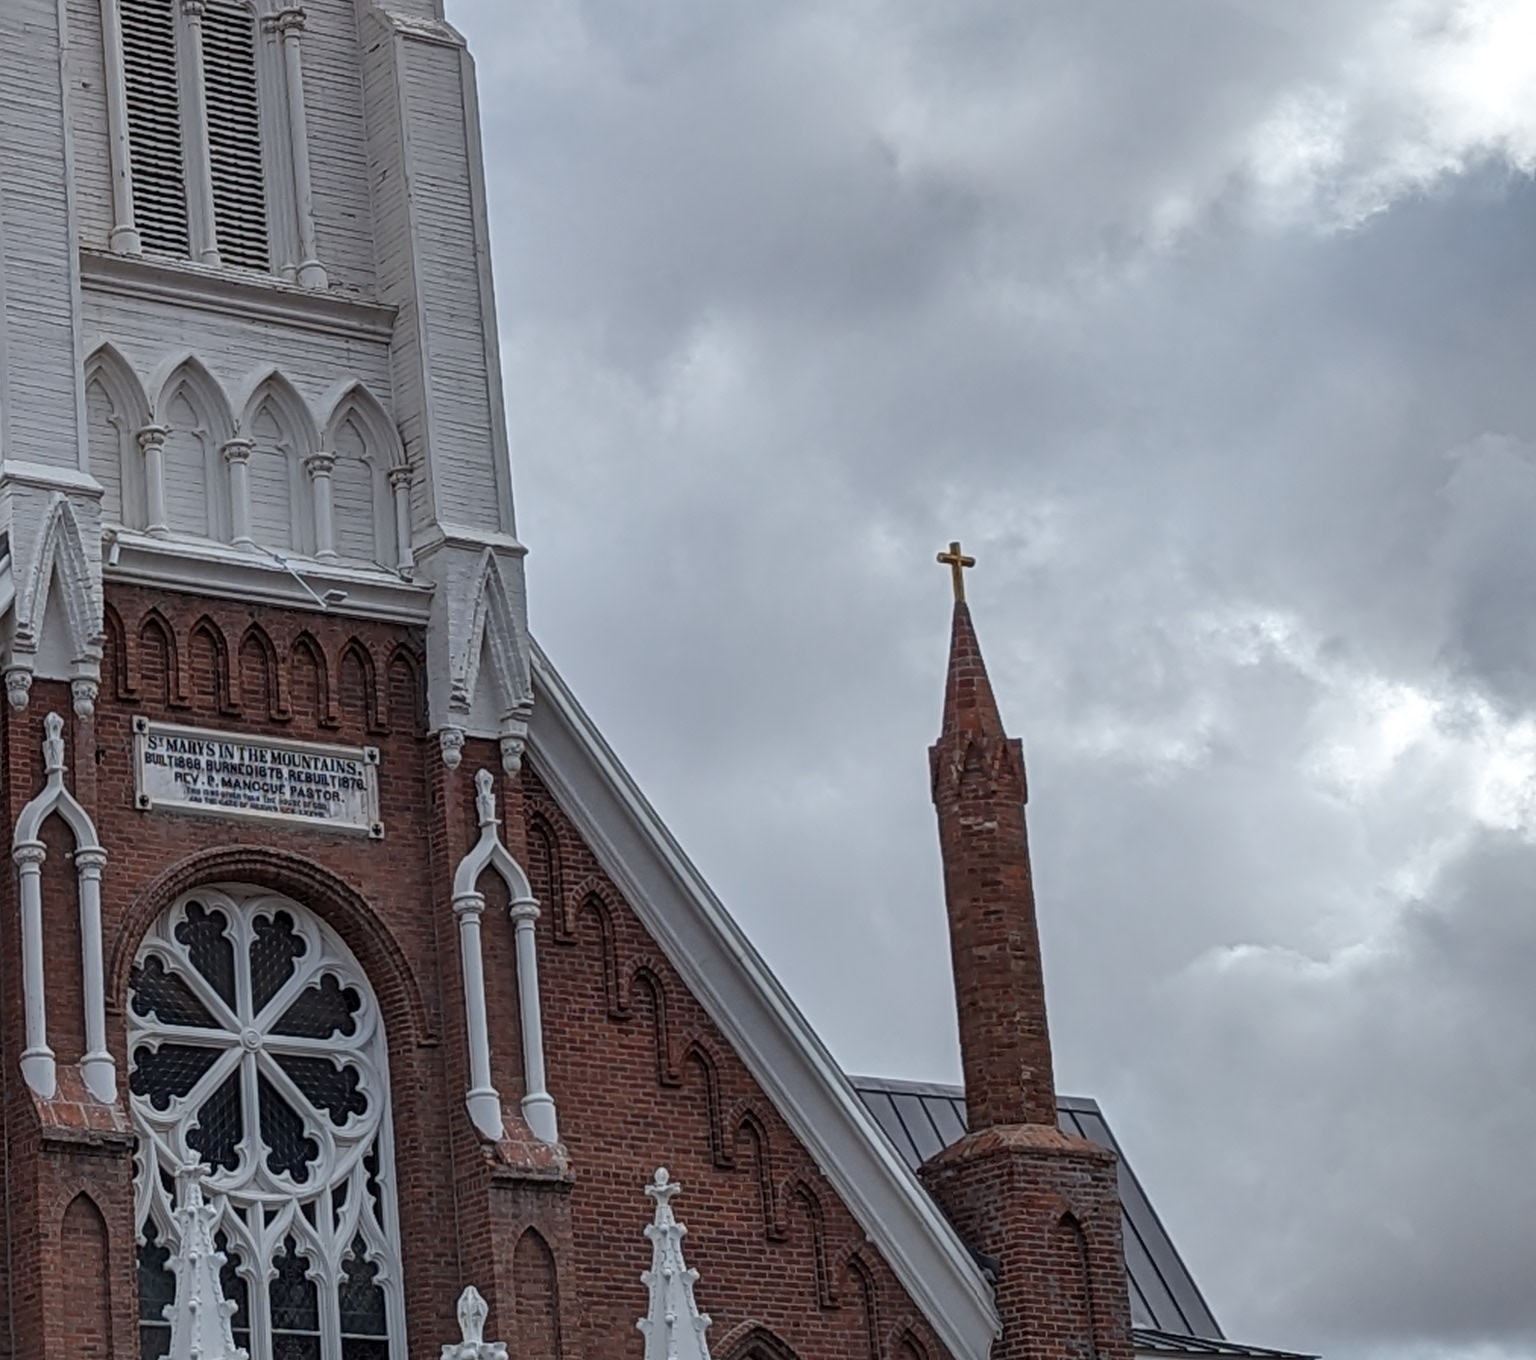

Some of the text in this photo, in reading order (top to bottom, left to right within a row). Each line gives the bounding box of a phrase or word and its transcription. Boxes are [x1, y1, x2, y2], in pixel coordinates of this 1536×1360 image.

[218, 744, 234, 760] IN
[237, 745, 268, 764] THE
[270, 750, 363, 777] MOUNTAINS.
